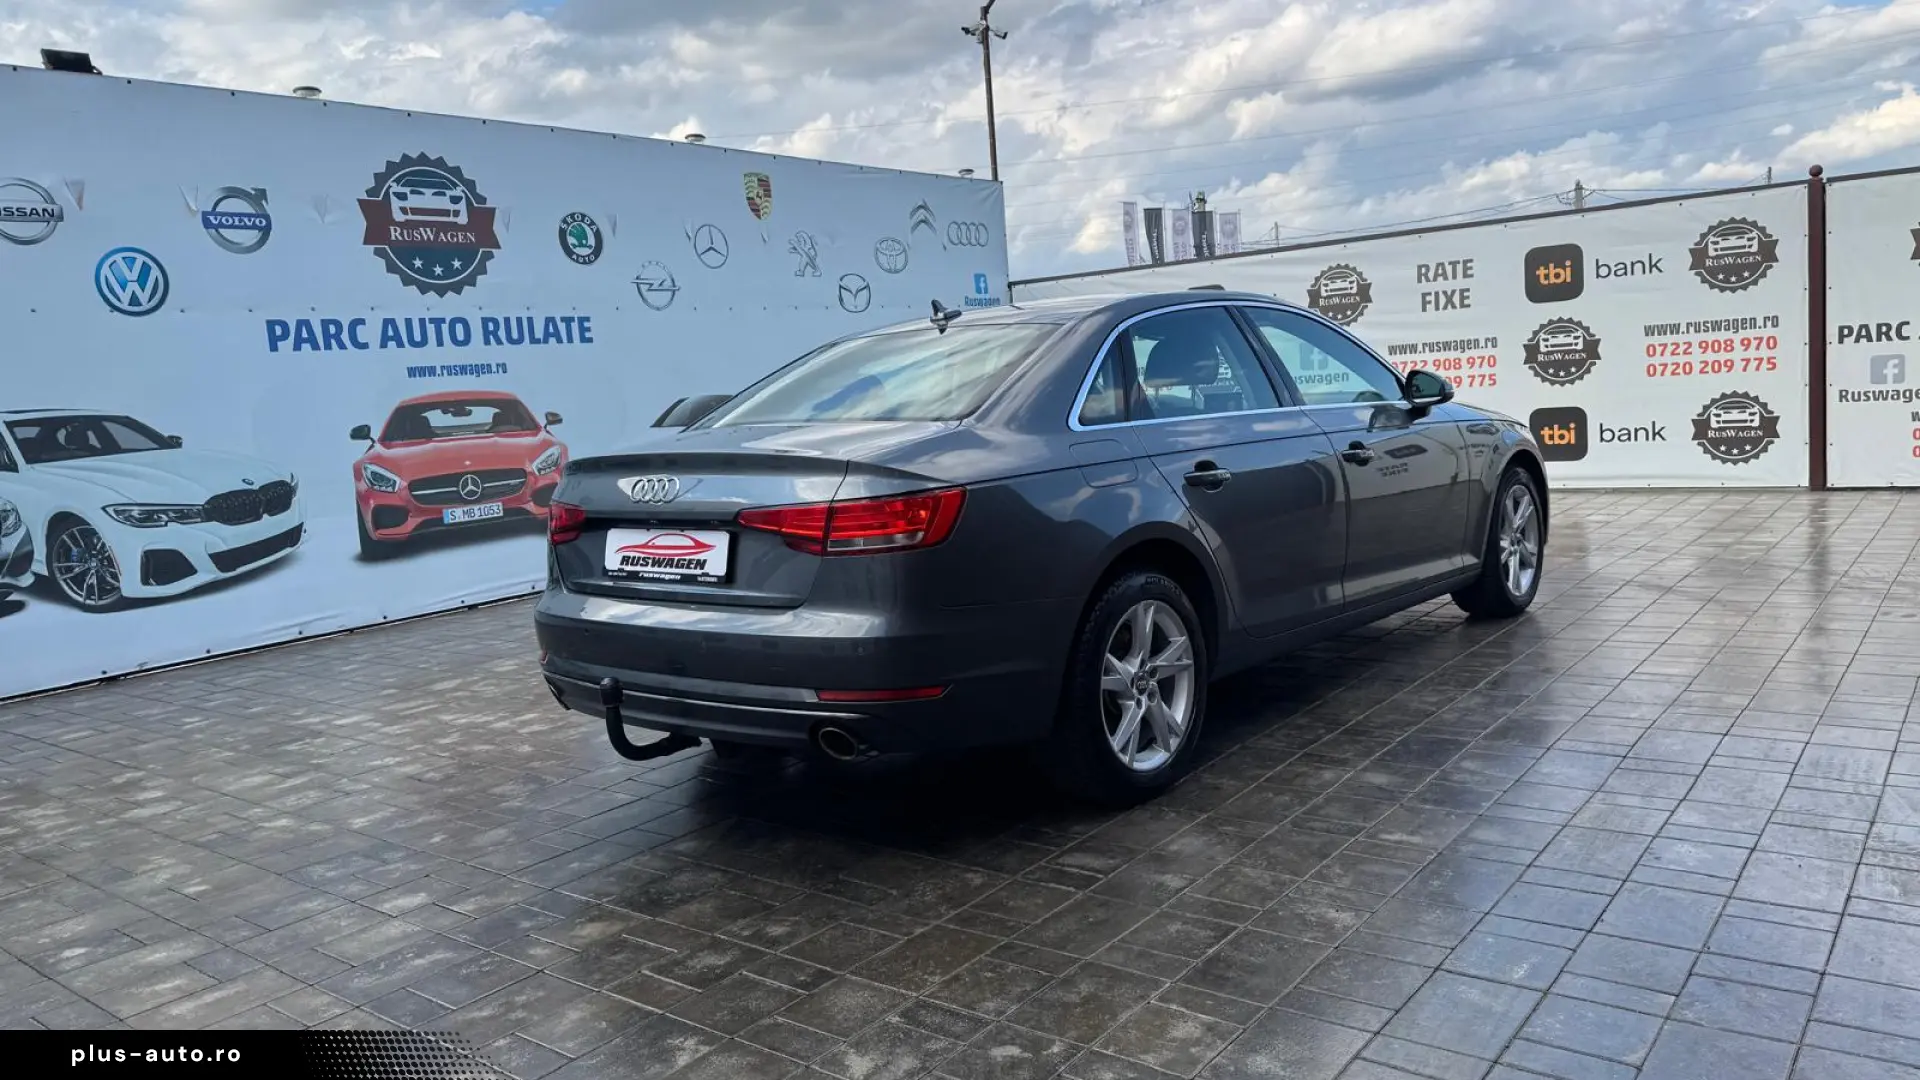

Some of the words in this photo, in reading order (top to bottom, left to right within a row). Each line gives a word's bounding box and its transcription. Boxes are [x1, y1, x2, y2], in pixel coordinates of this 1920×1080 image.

[206, 215, 267, 227] VOLVO
[388, 225, 476, 244] RUSWAGEN
[571, 253, 596, 263] AUTO
[1416, 258, 1475, 284] RATE
[1536, 260, 1572, 285] tbi
[1595, 253, 1664, 279] bank
[1421, 287, 1472, 313] FIXE
[265, 318, 370, 353] PARC
[379, 317, 472, 349] AUTO
[480, 316, 594, 346] RULATE
[1643, 315, 1780, 337] www.ruswagen.ro
[1837, 320, 1911, 345] PARC
[1387, 336, 1498, 356] www.ruswagen.ro
[1645, 342, 1693, 358] 0722
[1698, 338, 1735, 355] 908
[1740, 335, 1778, 352] 970
[406, 362, 508, 379] www.ruswagen.ro
[1432, 358, 1462, 371] 908
[1466, 354, 1497, 369] 970
[1646, 362, 1694, 378] 0720
[1698, 358, 1735, 375] 209
[1740, 356, 1777, 372] 775
[1468, 373, 1497, 388] 775
[1540, 423, 1576, 445] tbi
[1599, 421, 1667, 443] bank
[462, 507, 476, 519] MB
[476, 502, 501, 517] 1053
[620, 555, 707, 570] RUSWAGEN
